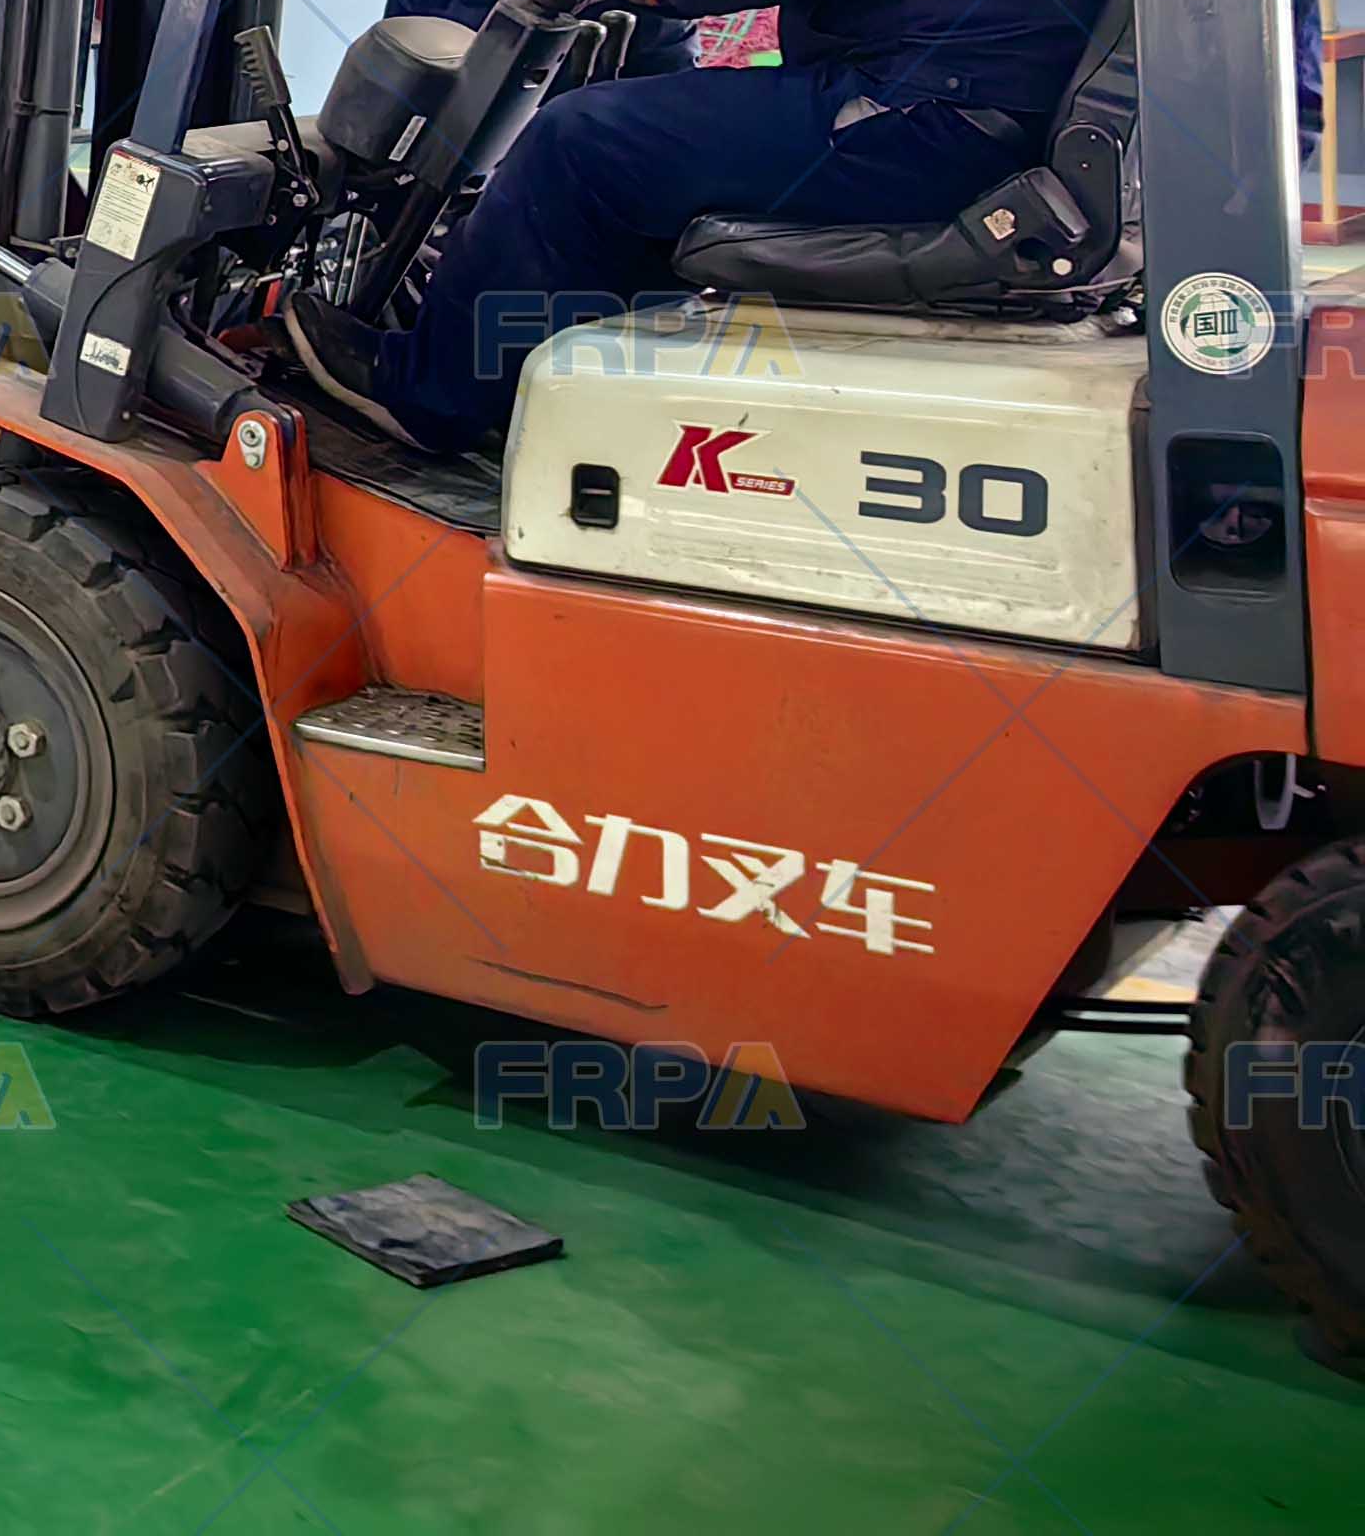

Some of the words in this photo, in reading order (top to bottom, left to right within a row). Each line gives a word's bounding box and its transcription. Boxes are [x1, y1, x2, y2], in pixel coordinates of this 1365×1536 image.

[657, 424, 759, 494] K
[733, 475, 789, 493] SERIES
[858, 450, 1049, 538] 30
[472, 792, 936, 957] 合力叉车
